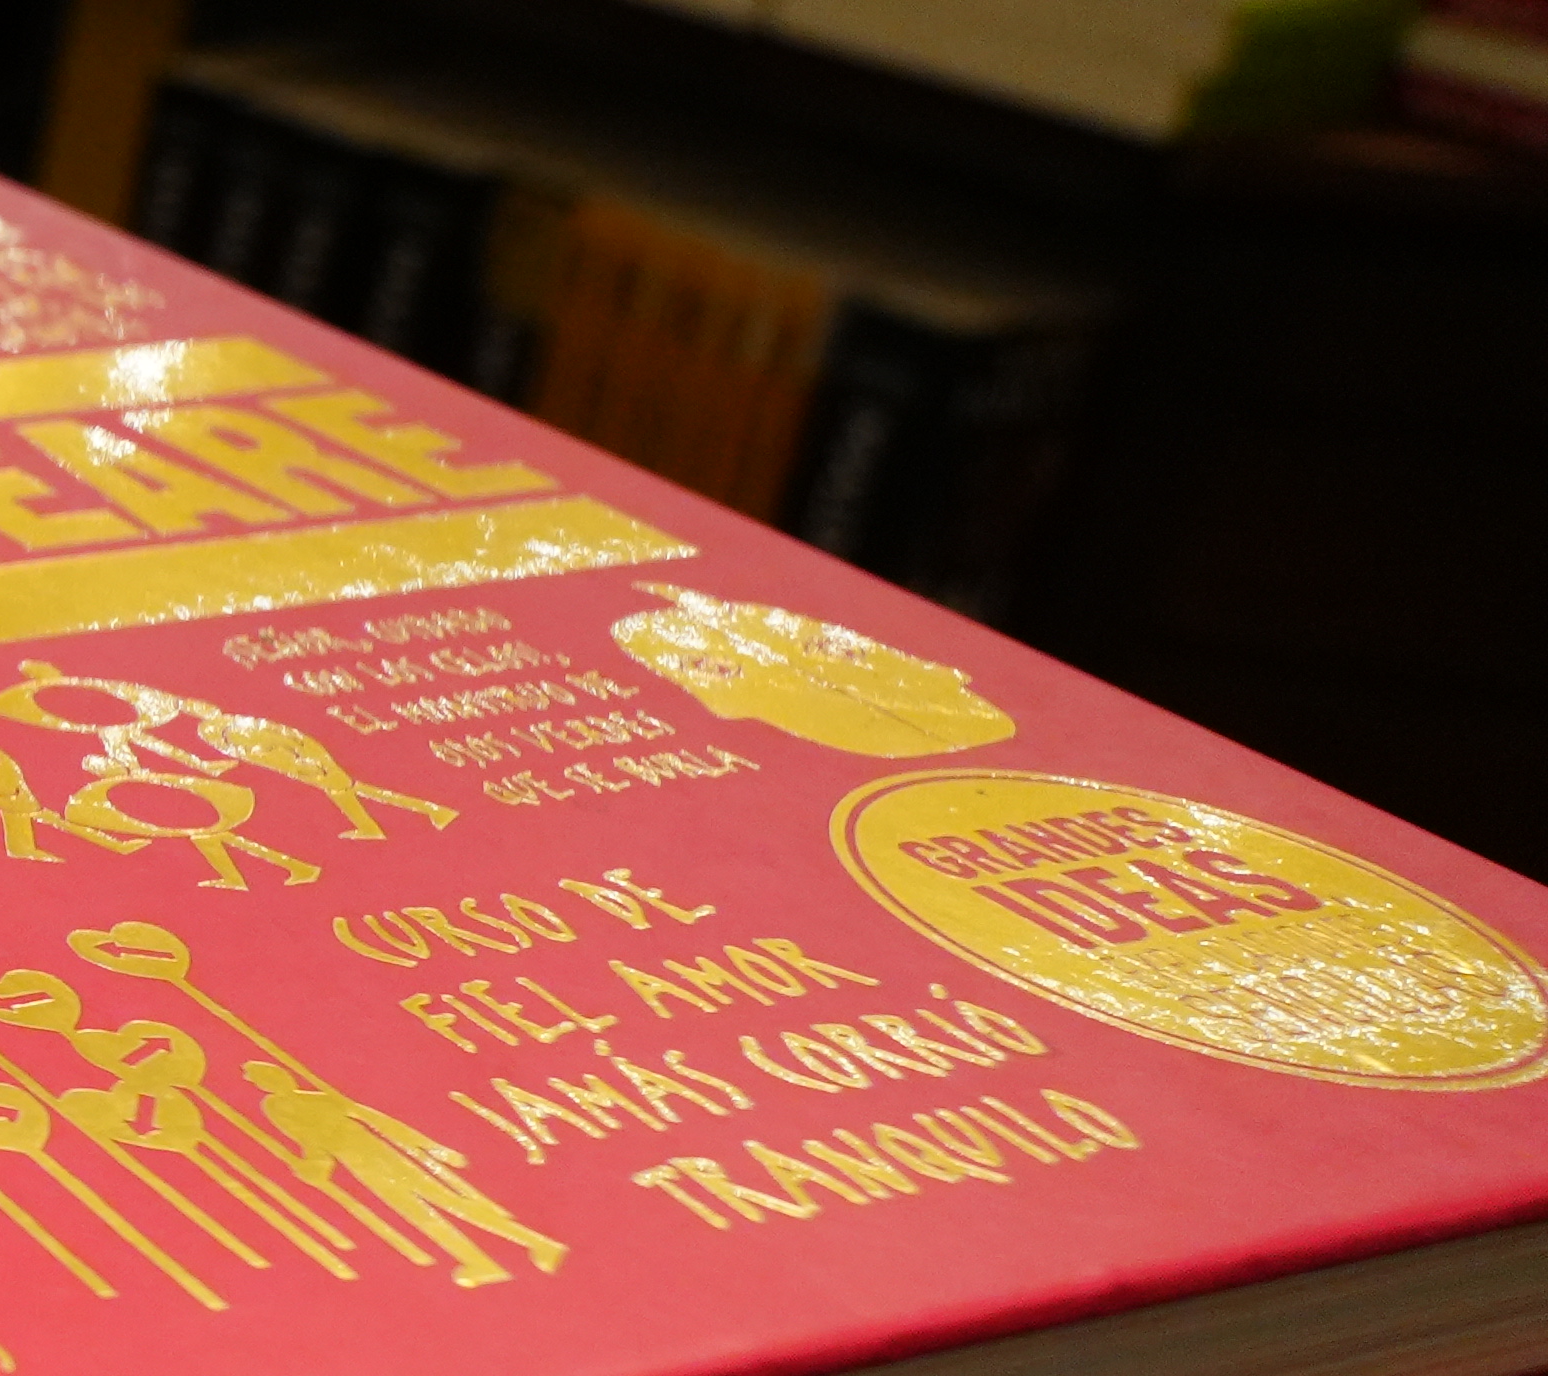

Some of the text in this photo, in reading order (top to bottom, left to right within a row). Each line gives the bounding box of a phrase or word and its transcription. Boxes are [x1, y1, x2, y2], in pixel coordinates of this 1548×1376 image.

[481, 768, 576, 807] QUE
[898, 805, 1193, 882] GRANDES
[330, 867, 719, 970] CURSO DE
[396, 935, 882, 1056] FIEL AMOR
[446, 980, 1052, 1167] JAMÁS CORRIÓ
[629, 1085, 1143, 1232] TRANQUILO
